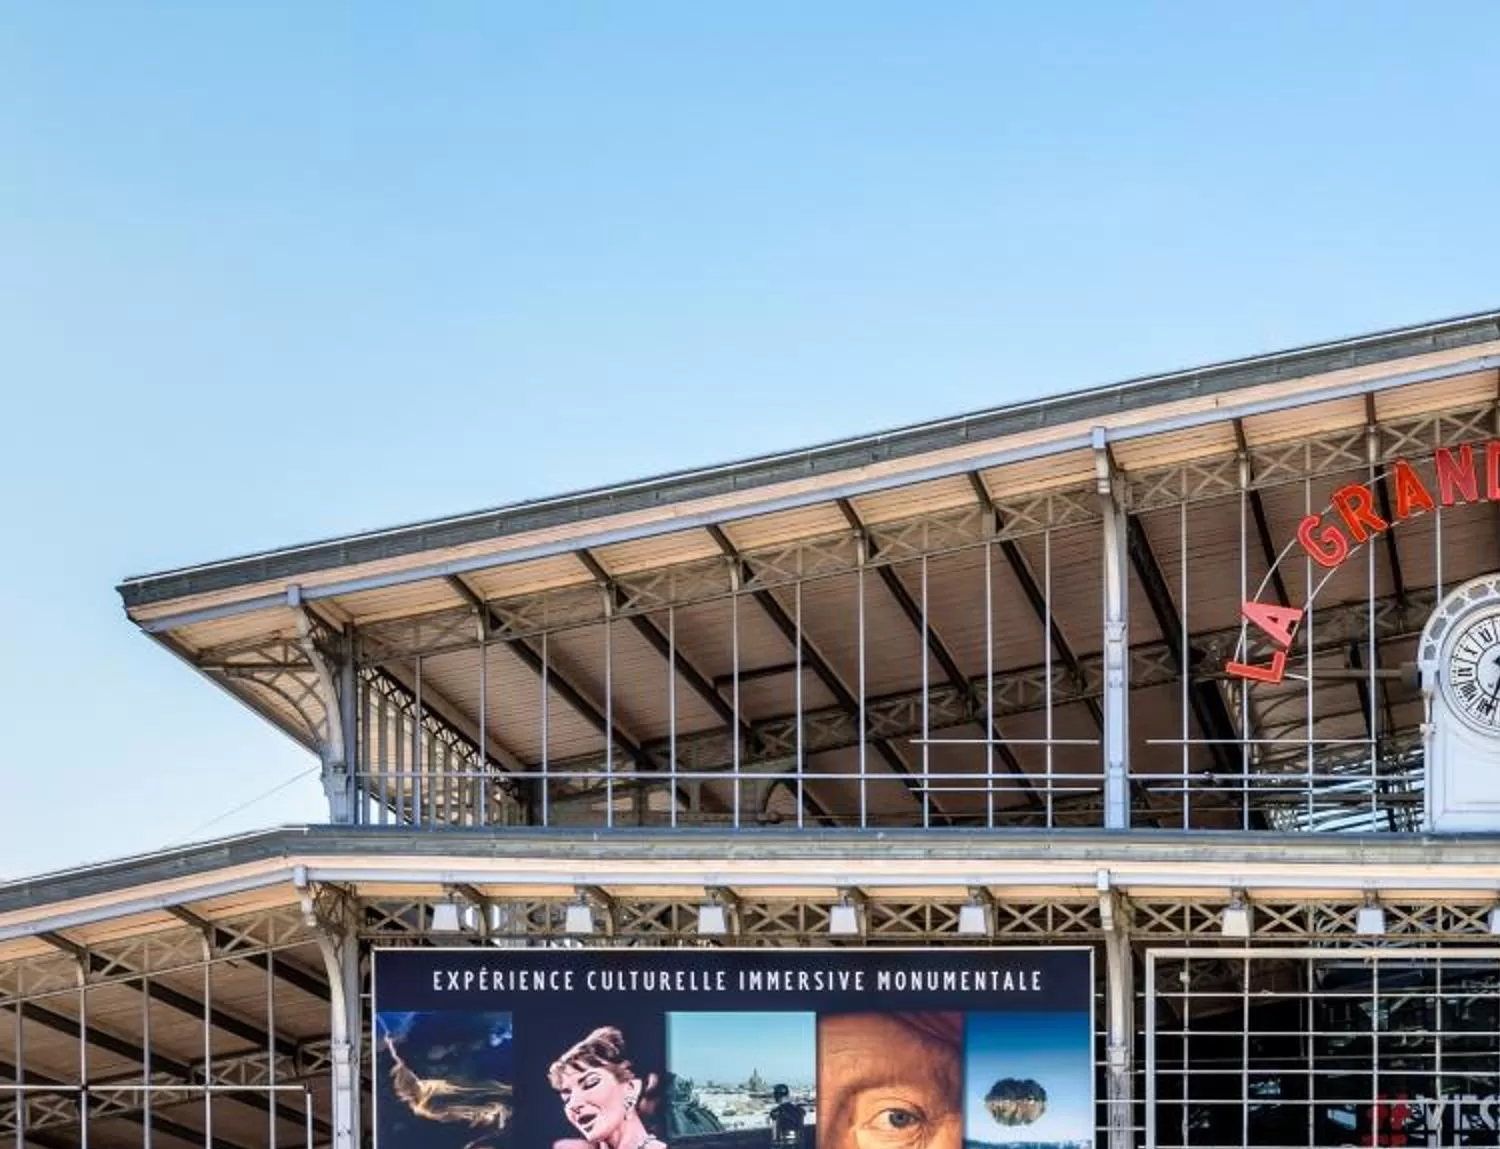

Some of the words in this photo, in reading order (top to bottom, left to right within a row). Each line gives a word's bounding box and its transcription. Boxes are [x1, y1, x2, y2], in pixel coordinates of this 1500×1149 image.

[1225, 599, 1306, 685] LA
[433, 967, 574, 991] EXPÉRIENCE
[587, 970, 726, 991] CULTURELLE
[739, 970, 865, 991] IMMERSIVE
[877, 970, 1042, 991] MONUMENTALE
